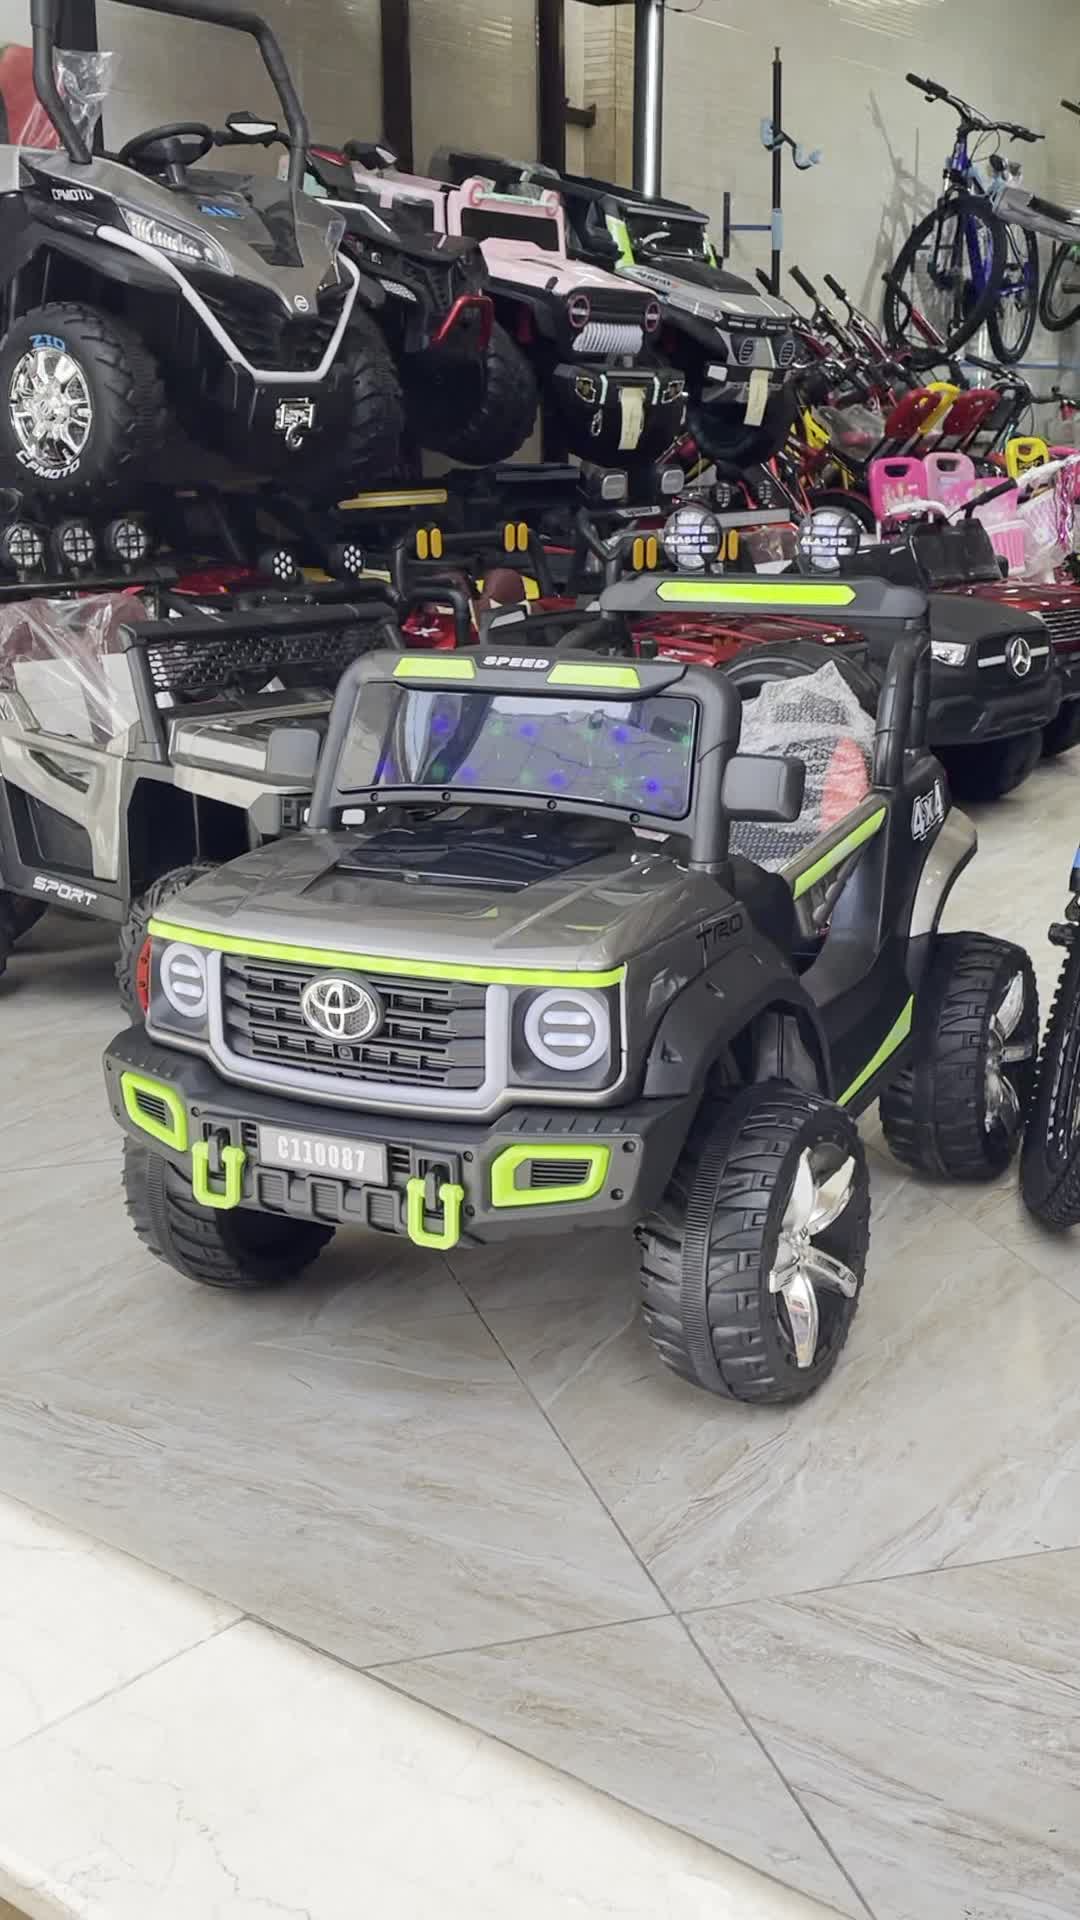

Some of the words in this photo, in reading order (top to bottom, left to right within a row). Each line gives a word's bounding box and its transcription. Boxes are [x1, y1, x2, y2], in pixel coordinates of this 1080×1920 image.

[483, 655, 549, 669] SPEED
[33, 876, 97, 905] SPORT
[278, 1135, 365, 1173] C110087
